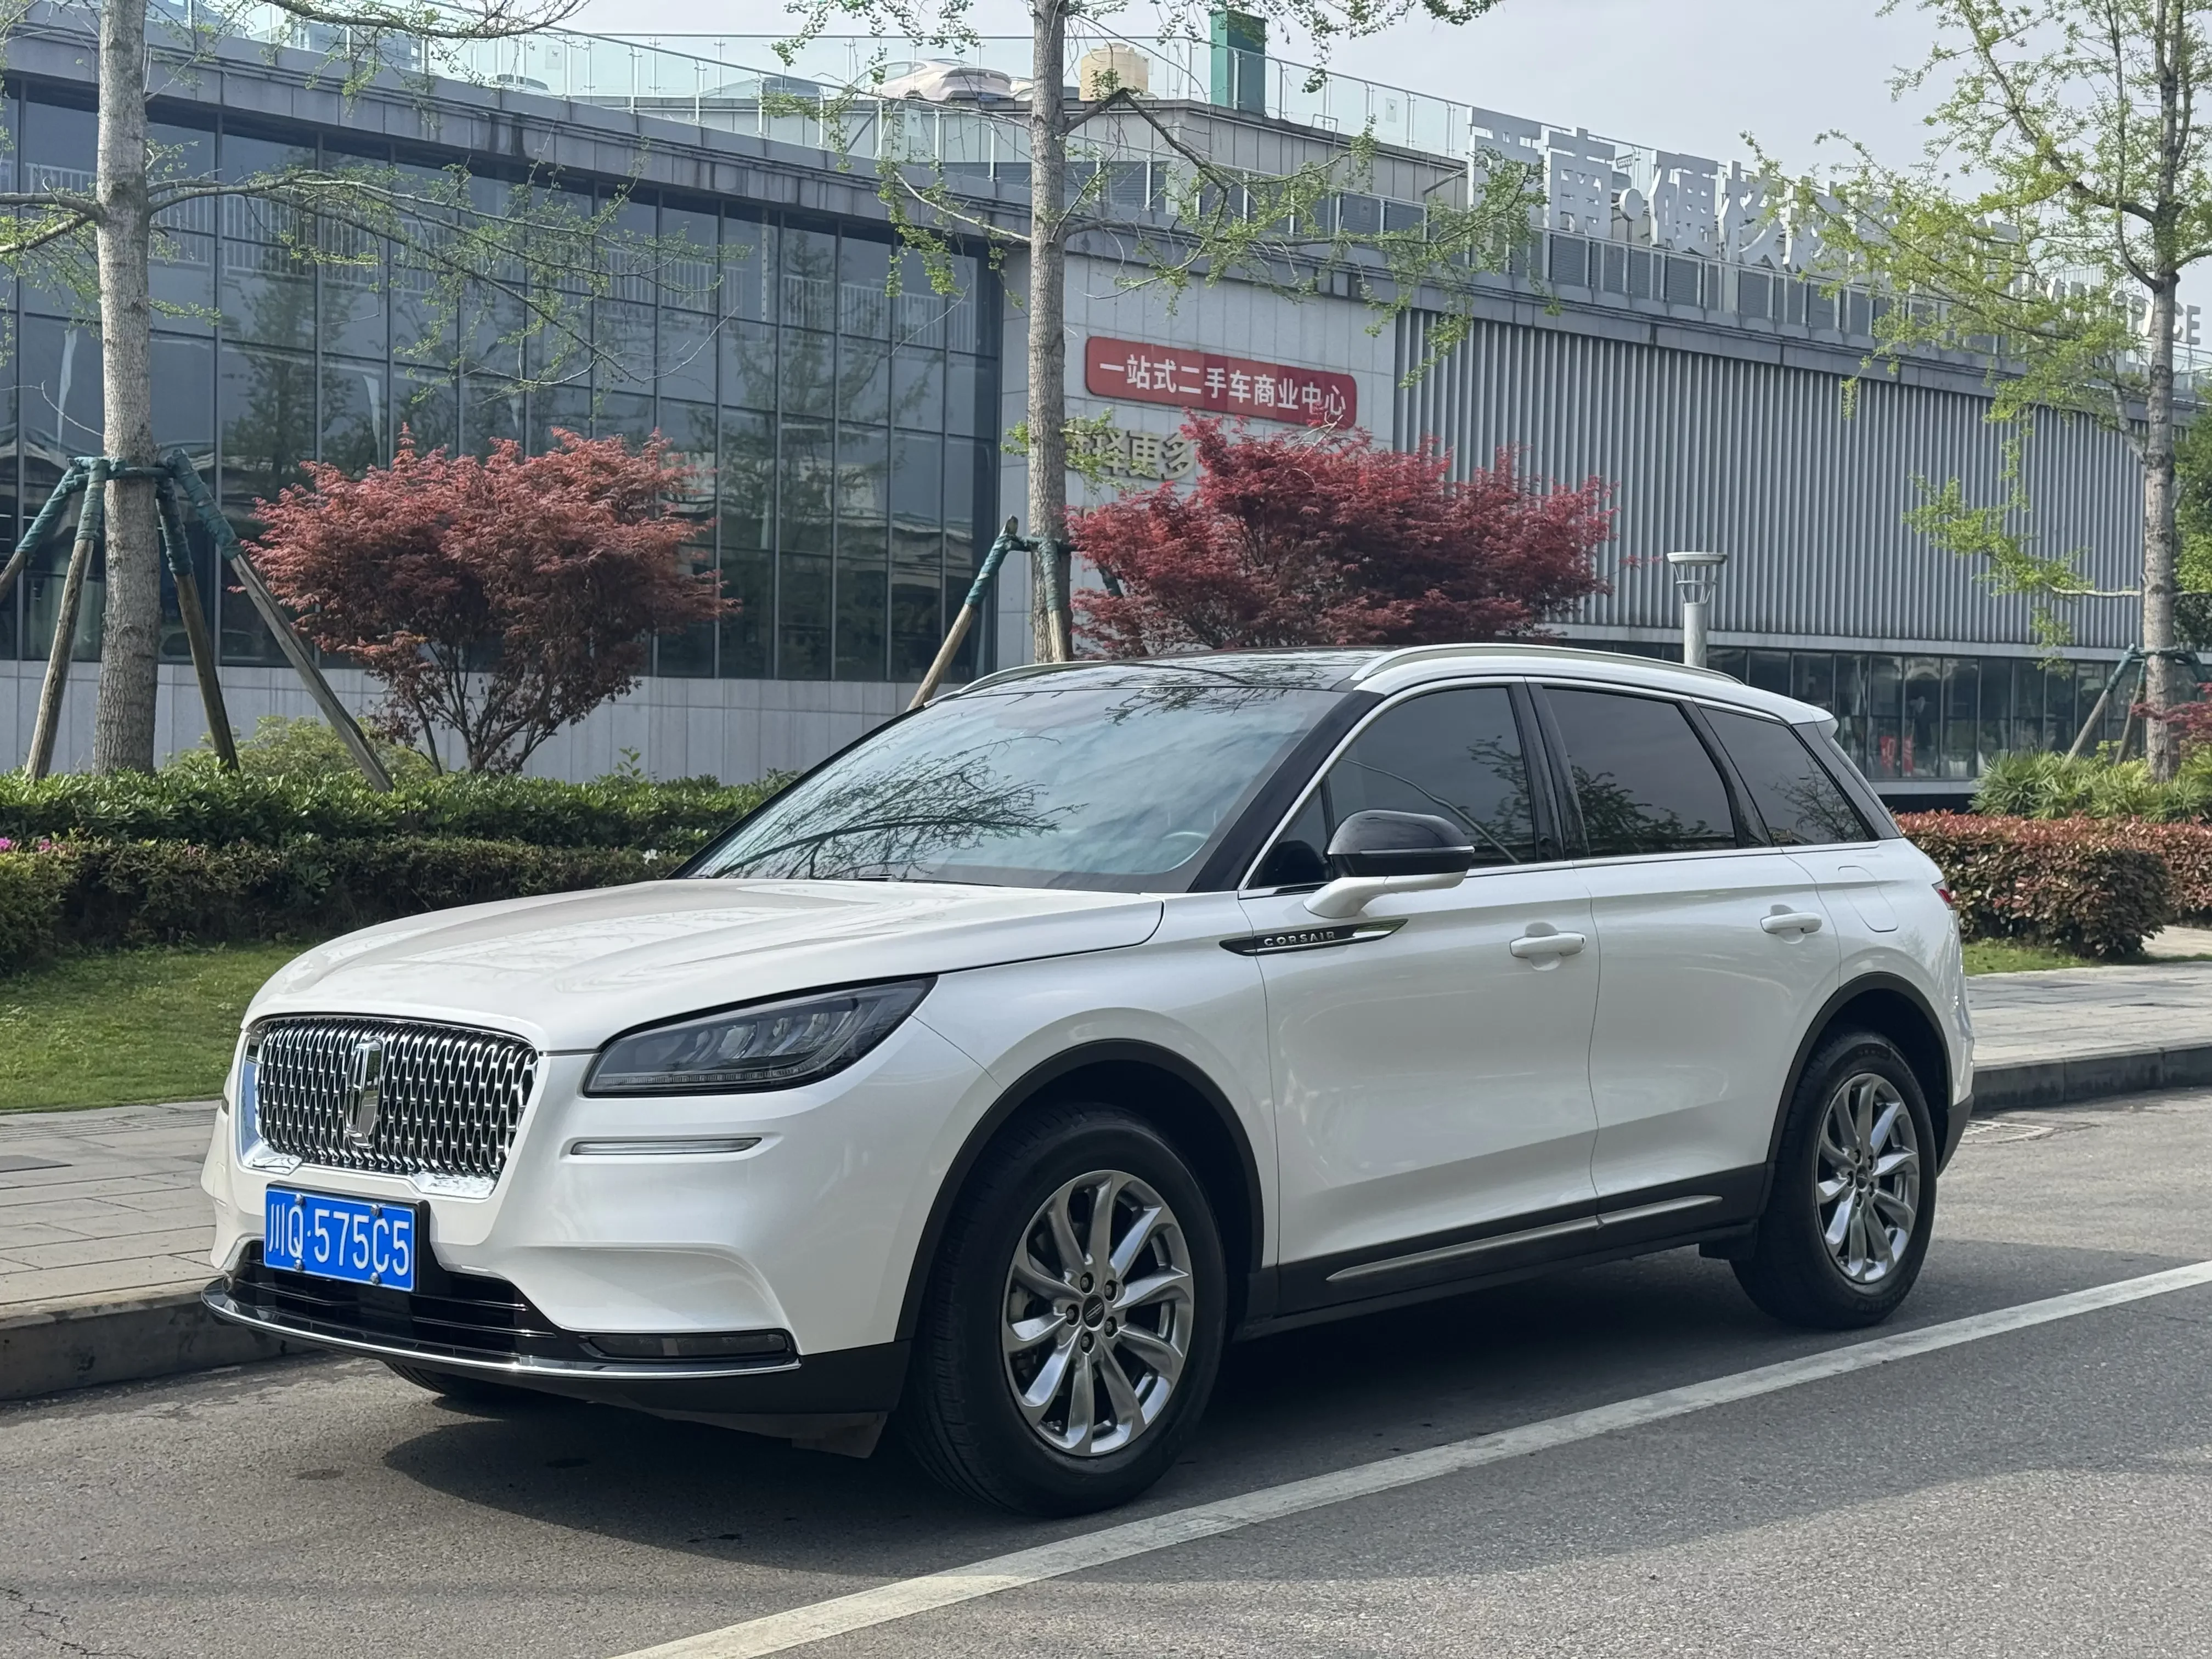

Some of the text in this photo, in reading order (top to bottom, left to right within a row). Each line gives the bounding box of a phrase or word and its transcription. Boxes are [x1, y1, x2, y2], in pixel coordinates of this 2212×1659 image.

[1099, 354, 1346, 416] 一站式二手车商业中心
[1263, 931, 1335, 947] CORSAIR
